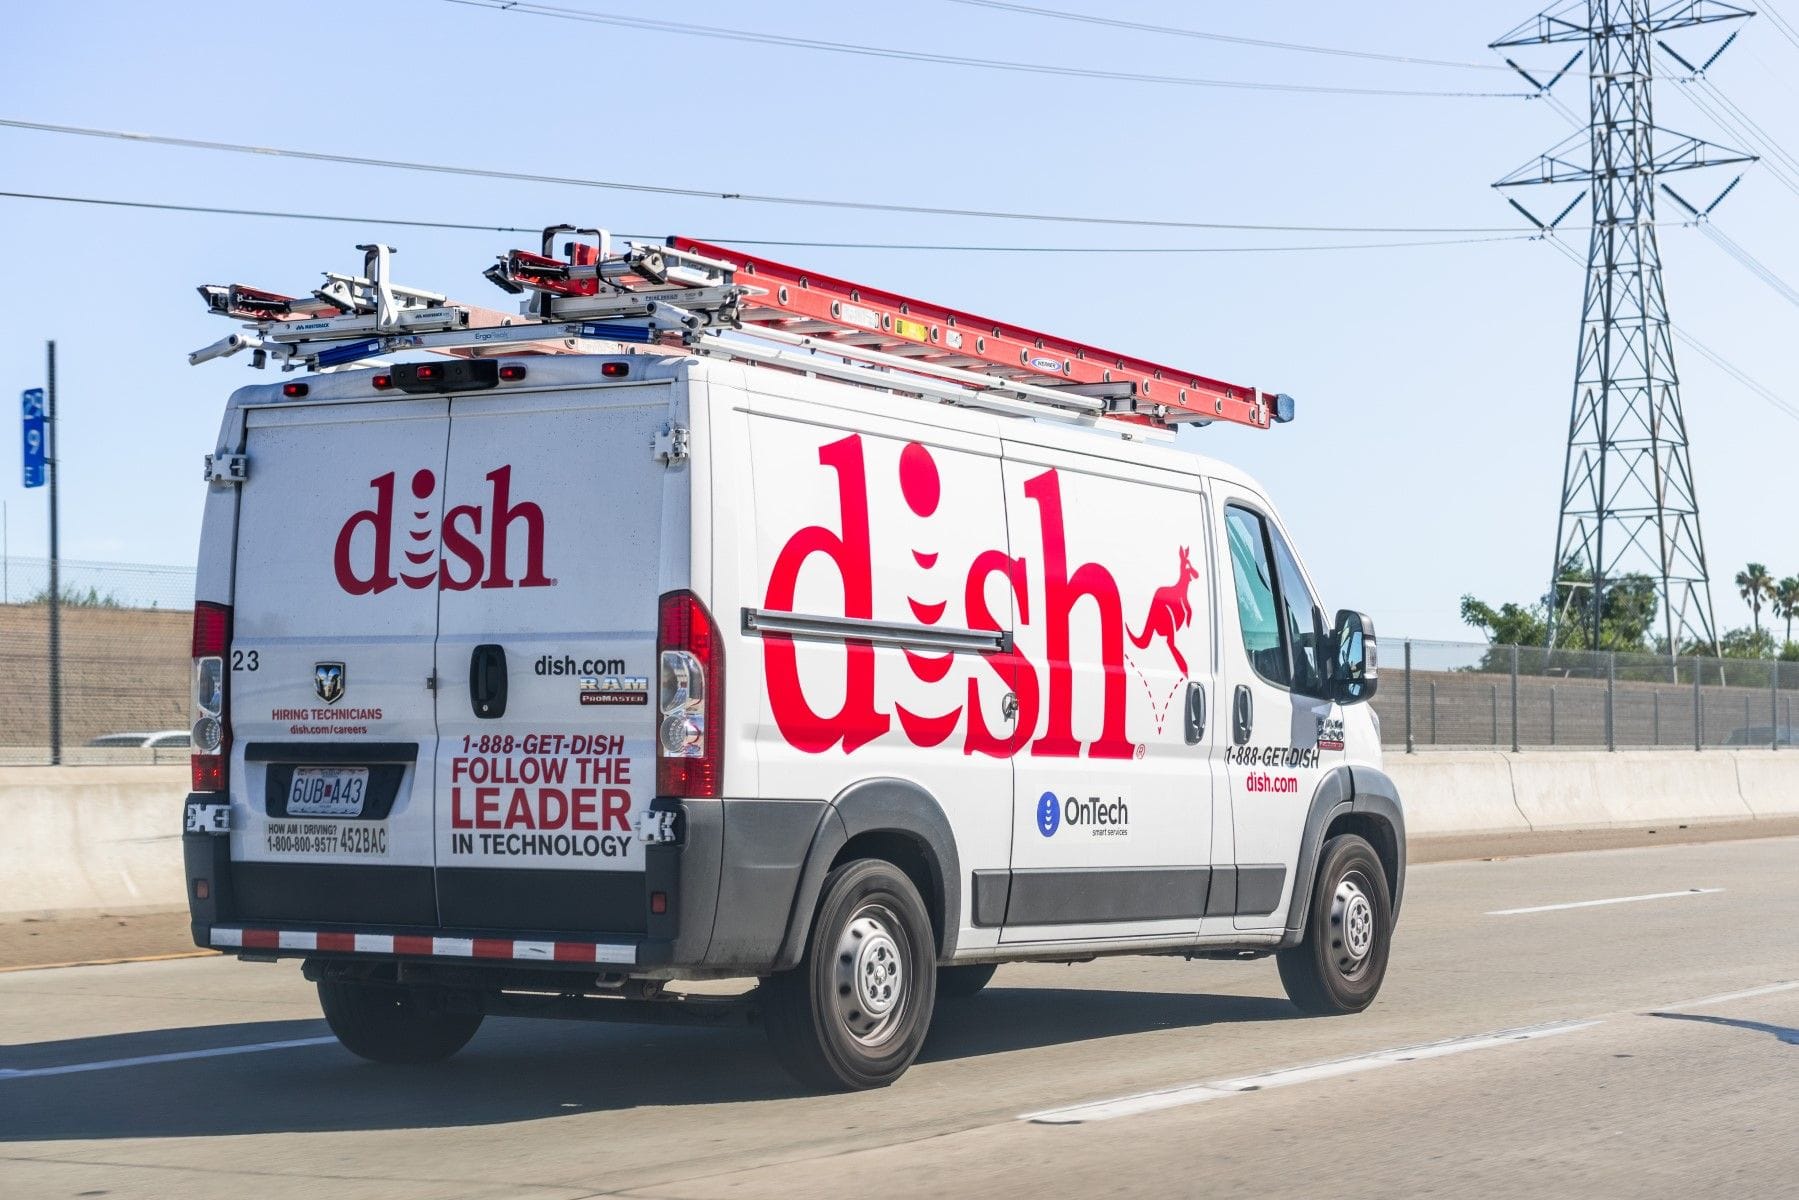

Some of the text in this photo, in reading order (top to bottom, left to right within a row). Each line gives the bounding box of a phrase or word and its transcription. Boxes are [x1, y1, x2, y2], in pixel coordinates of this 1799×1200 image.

[334, 464, 552, 595] dish
[764, 434, 1134, 759] dish
[232, 650, 259, 671] 23
[535, 655, 625, 675] dish.com
[580, 676, 648, 690] RAM
[272, 708, 382, 720] HIRING TECHNICIANS
[290, 725, 367, 734] dish.com/careers
[462, 734, 624, 755] 1-888-GET-DISH
[1226, 746, 1321, 768] 1-888-GET-DISH
[452, 757, 631, 784] FOLLOW THE
[1246, 772, 1298, 792] dish.com
[452, 788, 632, 831] LEADER
[1065, 797, 1128, 825] OnTech
[268, 824, 285, 834] HOW
[287, 824, 297, 834] AM
[303, 825, 337, 835] DRIVING?
[268, 836, 338, 852] 1-800-800-9577
[340, 828, 386, 853] 452BAC
[452, 834, 632, 857] IN TECHNOLOGY
